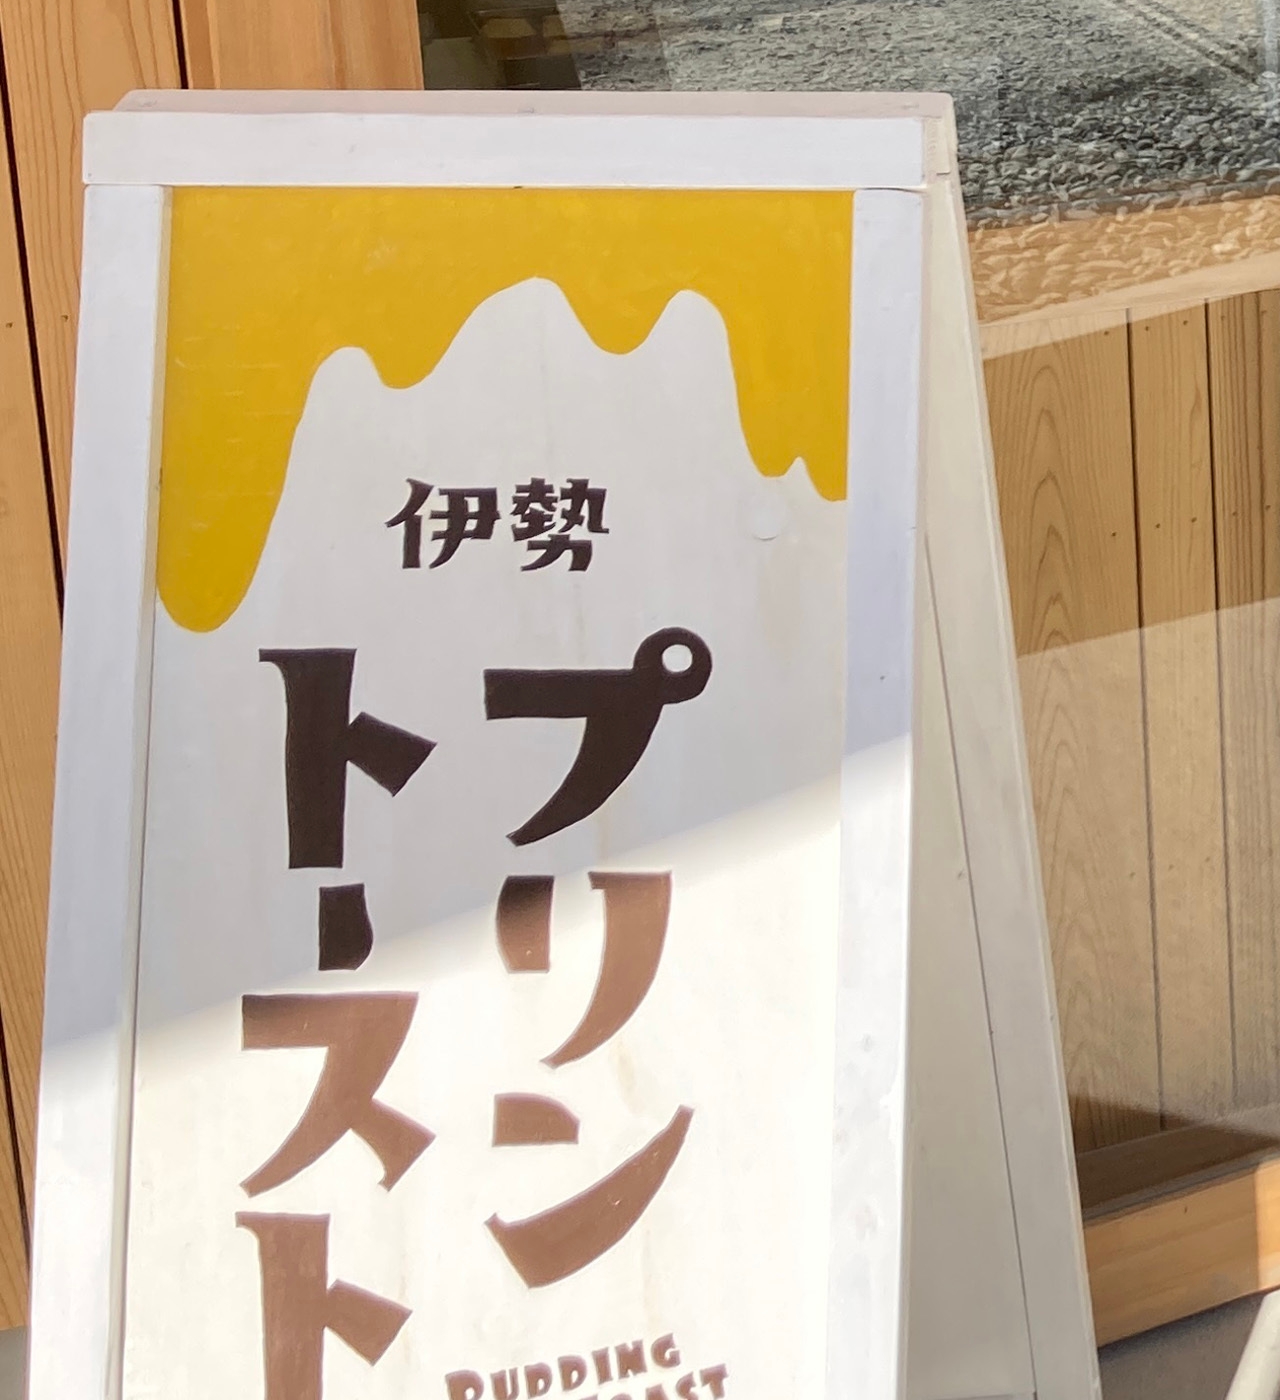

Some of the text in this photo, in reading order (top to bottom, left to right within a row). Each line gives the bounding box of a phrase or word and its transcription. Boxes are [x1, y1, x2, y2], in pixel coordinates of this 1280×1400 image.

[386, 478, 611, 573] 伊勢
[234, 648, 438, 1400] トースト
[483, 626, 713, 1289] プリン
[445, 1332, 681, 1400] PUDDING
